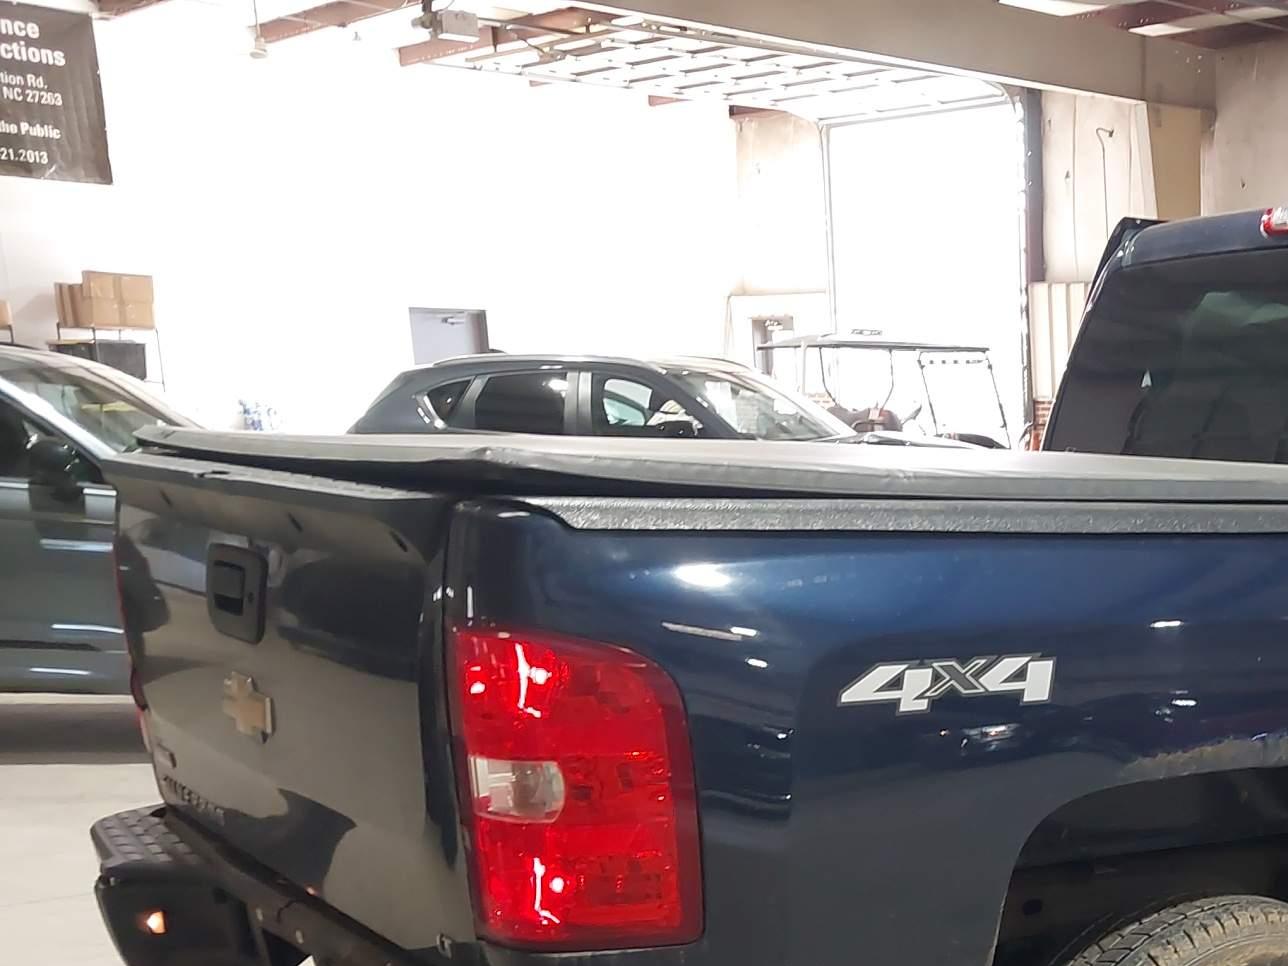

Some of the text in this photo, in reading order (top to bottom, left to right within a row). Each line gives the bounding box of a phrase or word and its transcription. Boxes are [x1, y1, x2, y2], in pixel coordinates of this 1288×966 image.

[0, 18, 40, 39] nce
[0, 41, 66, 66] ctions
[26, 73, 48, 89] Rd.
[2, 86, 23, 102] NC
[20, 122, 62, 140] Public
